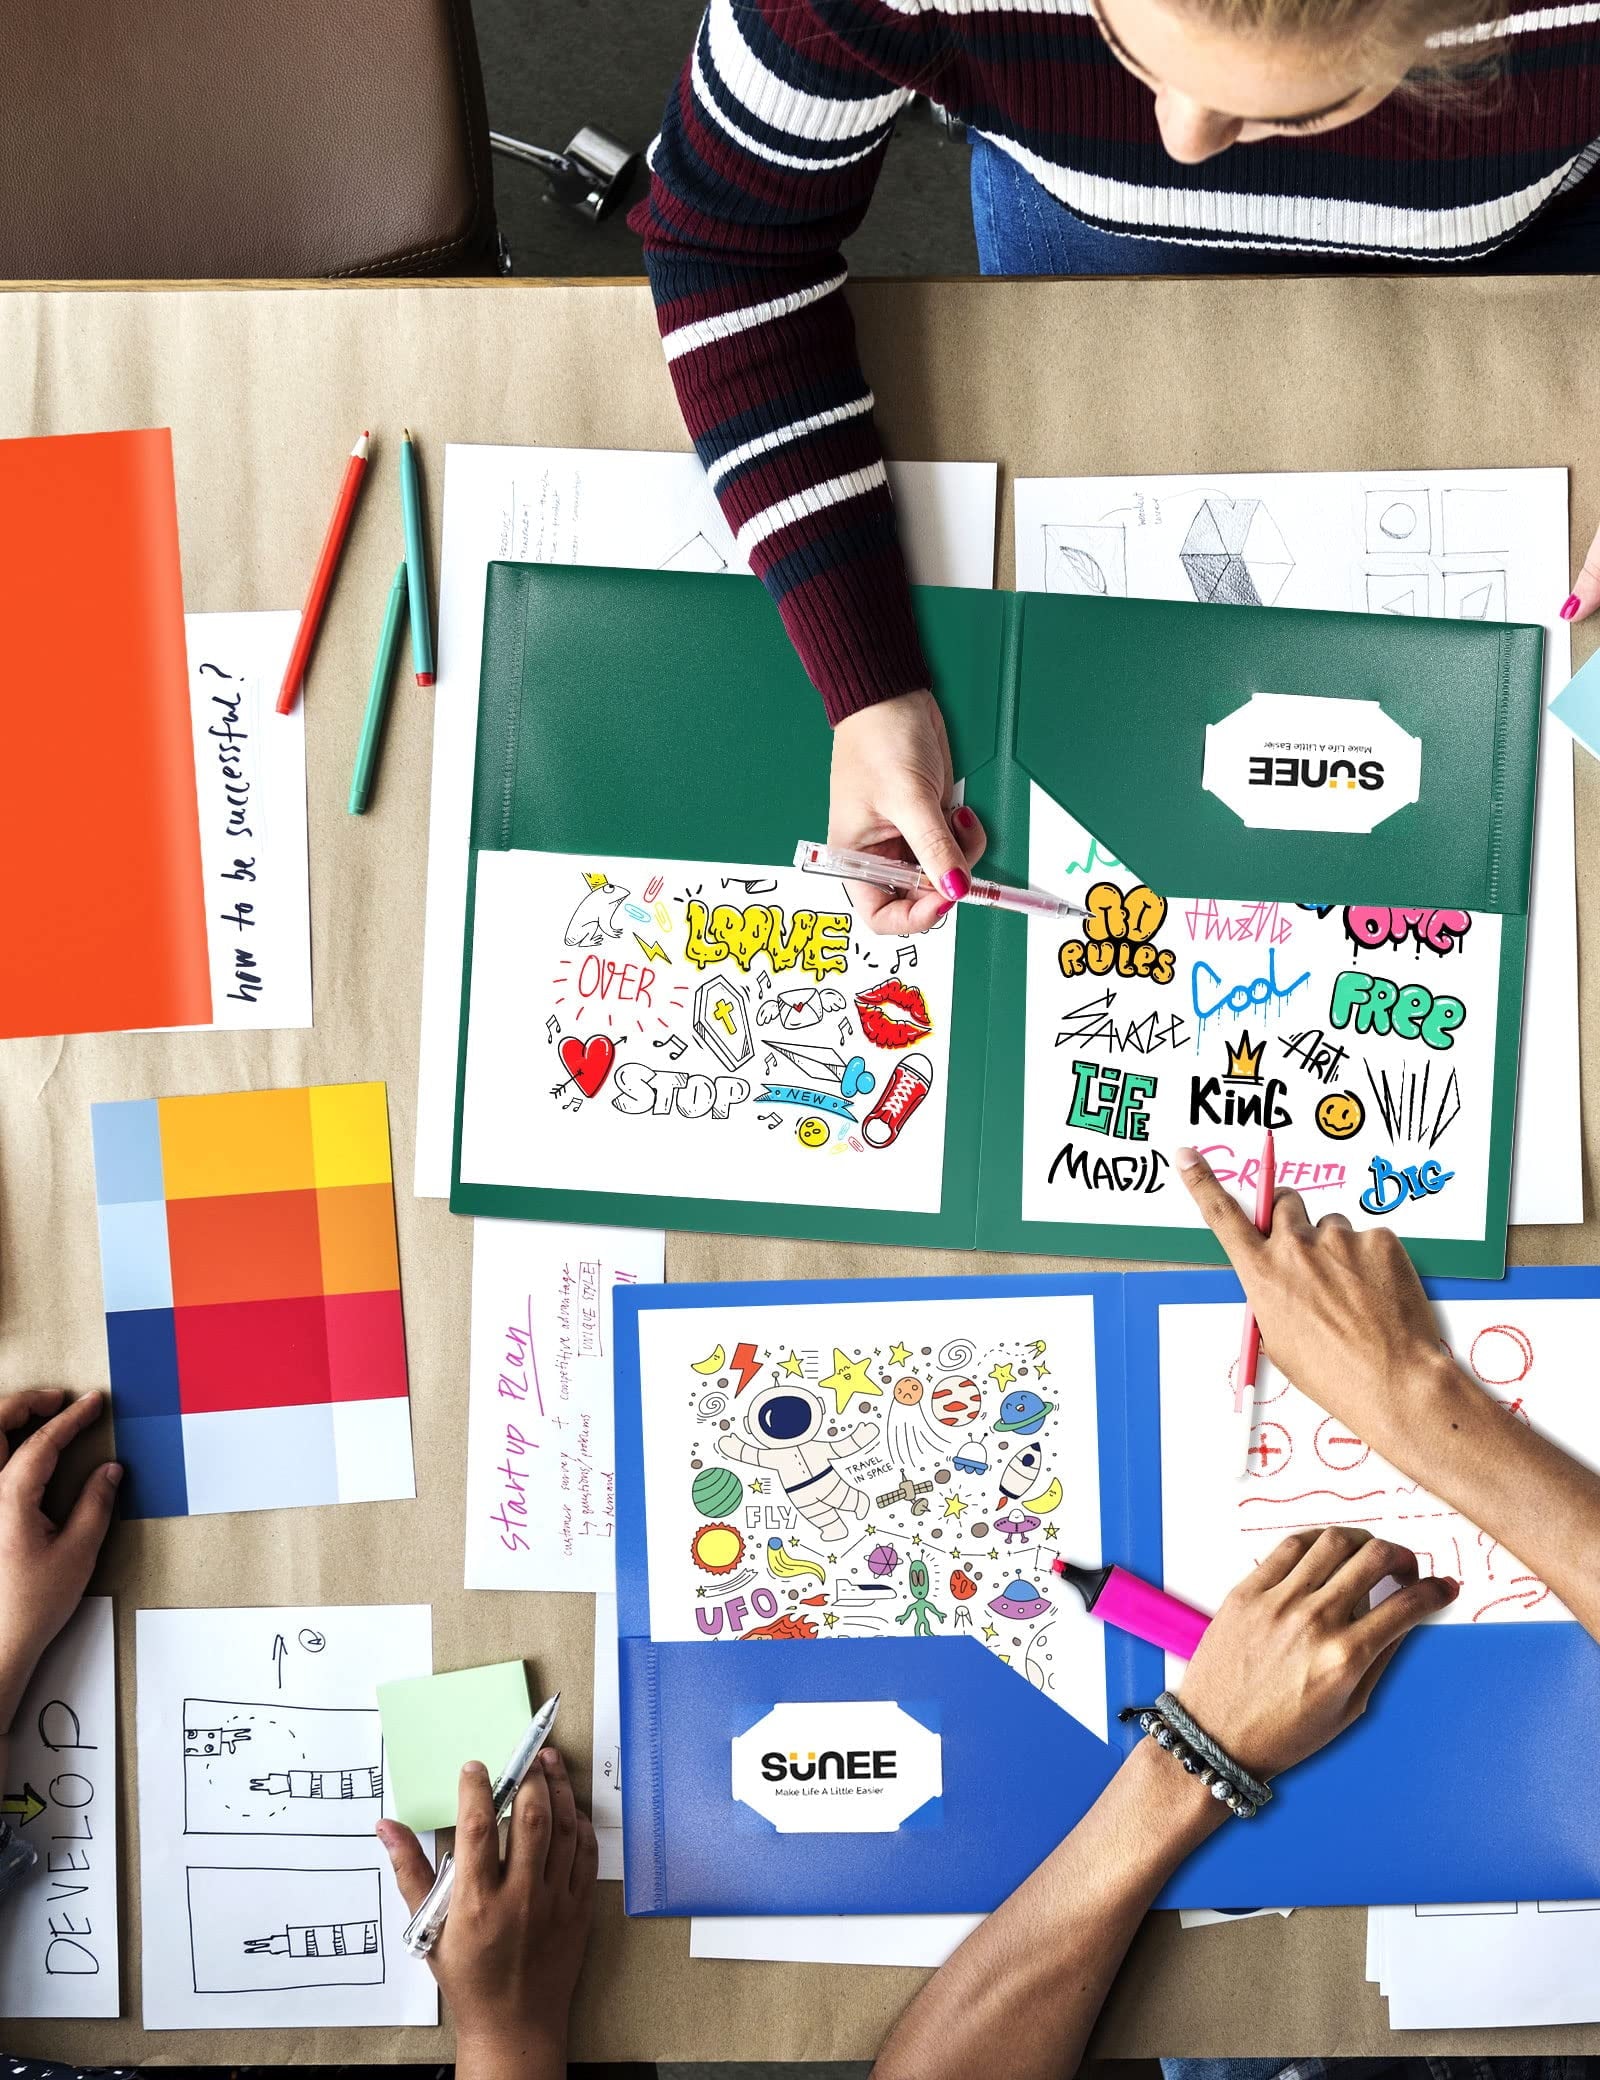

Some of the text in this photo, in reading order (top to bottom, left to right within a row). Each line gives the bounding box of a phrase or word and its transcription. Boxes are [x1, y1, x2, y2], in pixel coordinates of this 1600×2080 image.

[1263, 741, 1373, 755] Make Life A Little Easier
[220, 857, 256, 882] be
[220, 902, 255, 932] to
[226, 948, 262, 1002] how
[578, 954, 656, 1008] OVER
[1278, 1030, 1350, 1084] ART
[611, 1062, 751, 1120] STOP
[786, 1088, 827, 1104] NEW
[1363, 1056, 1461, 1150] WILD
[1191, 1145, 1347, 1192] GRFFITI
[1359, 1155, 1456, 1215] BIG
[557, 1263, 576, 1330] advantage
[582, 1266, 596, 1350] UNIQUE STYLE
[555, 1336, 573, 1401] competitive
[560, 1452, 577, 1491] survey
[845, 1455, 884, 1476] TRAVEL
[853, 1461, 894, 1484] IN SPACE
[600, 1472, 614, 1517] demand
[745, 1505, 798, 1530] FLY
[695, 1588, 778, 1635] UFO
[775, 1786, 884, 1797] Make Life A Little Easier
[38, 1699, 99, 1975] DEVELOP
